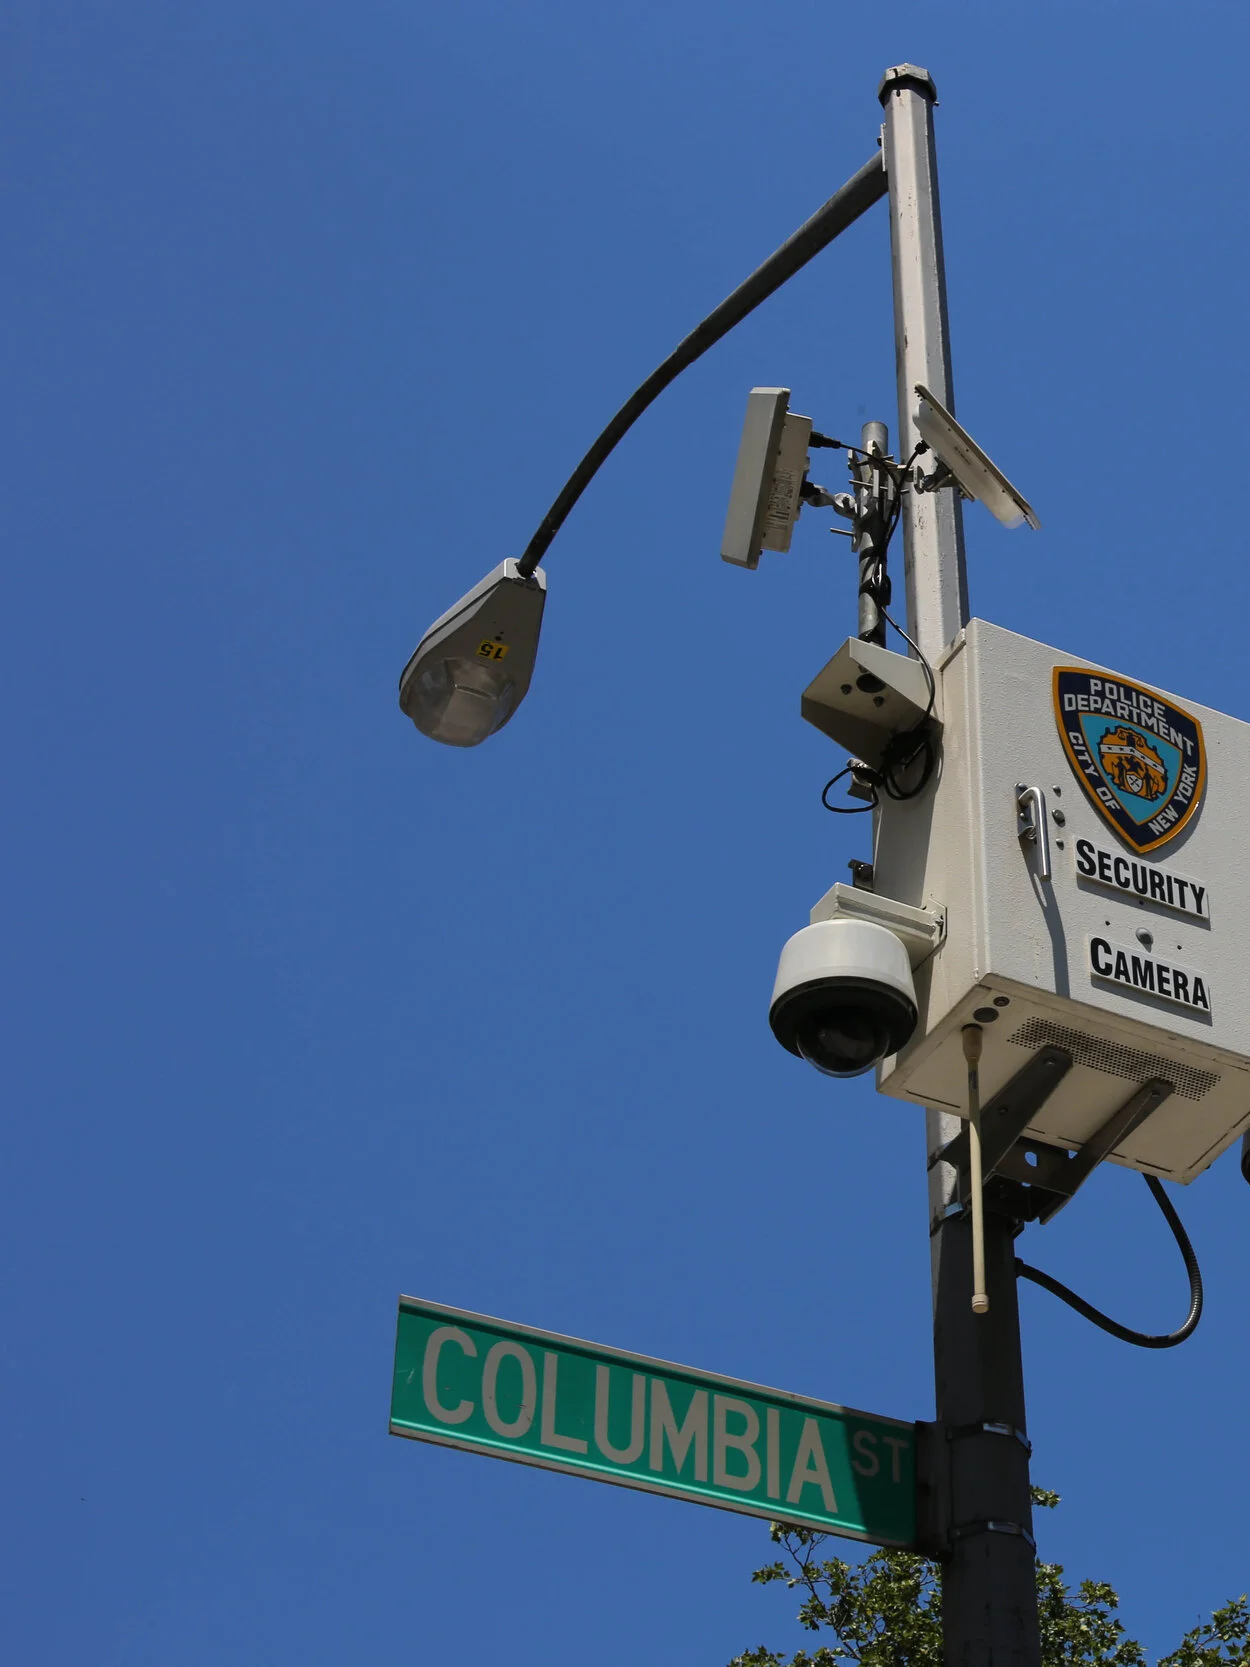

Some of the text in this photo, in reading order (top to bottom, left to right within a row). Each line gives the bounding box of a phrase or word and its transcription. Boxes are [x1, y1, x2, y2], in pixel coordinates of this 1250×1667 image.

[1063, 693, 1194, 756] DEPARTMENT
[1090, 679, 1167, 722] POLICE
[1068, 731, 1120, 810] CITY OF
[1148, 763, 1197, 836] NEW YORK
[1076, 839, 1205, 915] SECURITY
[1090, 937, 1209, 1010] CAMERA
[422, 1326, 909, 1514] COLUMBIA ST
